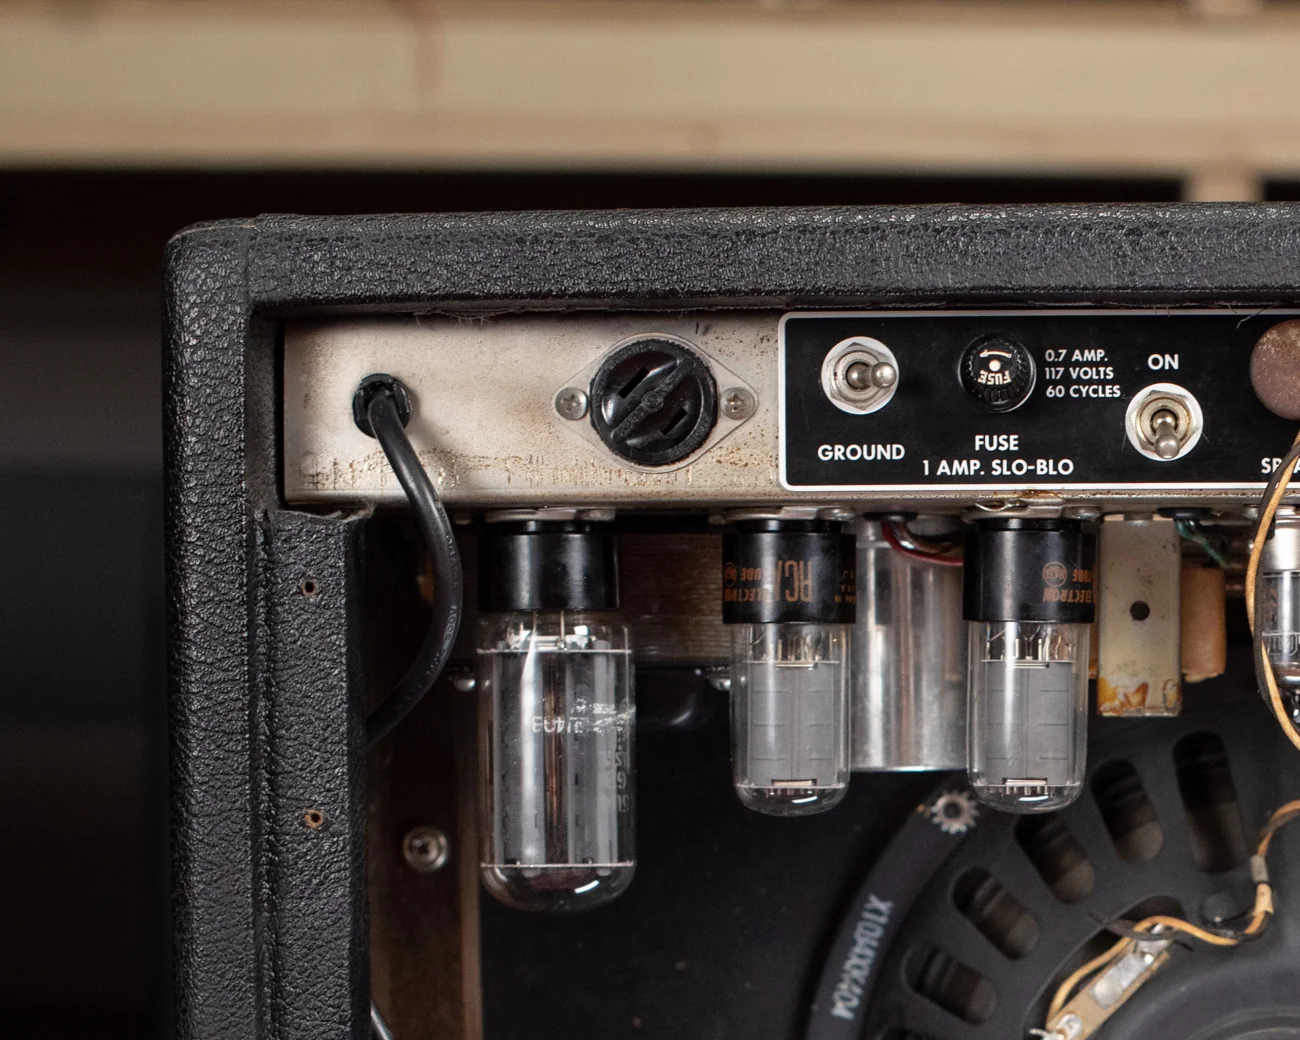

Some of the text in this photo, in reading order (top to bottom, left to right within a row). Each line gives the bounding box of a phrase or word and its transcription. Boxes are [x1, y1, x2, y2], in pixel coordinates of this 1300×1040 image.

[1045, 349, 1108, 362] 0.7 AMP.
[1147, 354, 1179, 371] ON
[977, 369, 1012, 385] FUSE
[1044, 367, 1115, 380] 117 VOLTS
[1045, 385, 1122, 398] 60 CYCLES
[974, 434, 1019, 452] FUSE
[817, 444, 905, 461] GROUND
[922, 459, 1075, 476] 1 AMP. SLO-BLO
